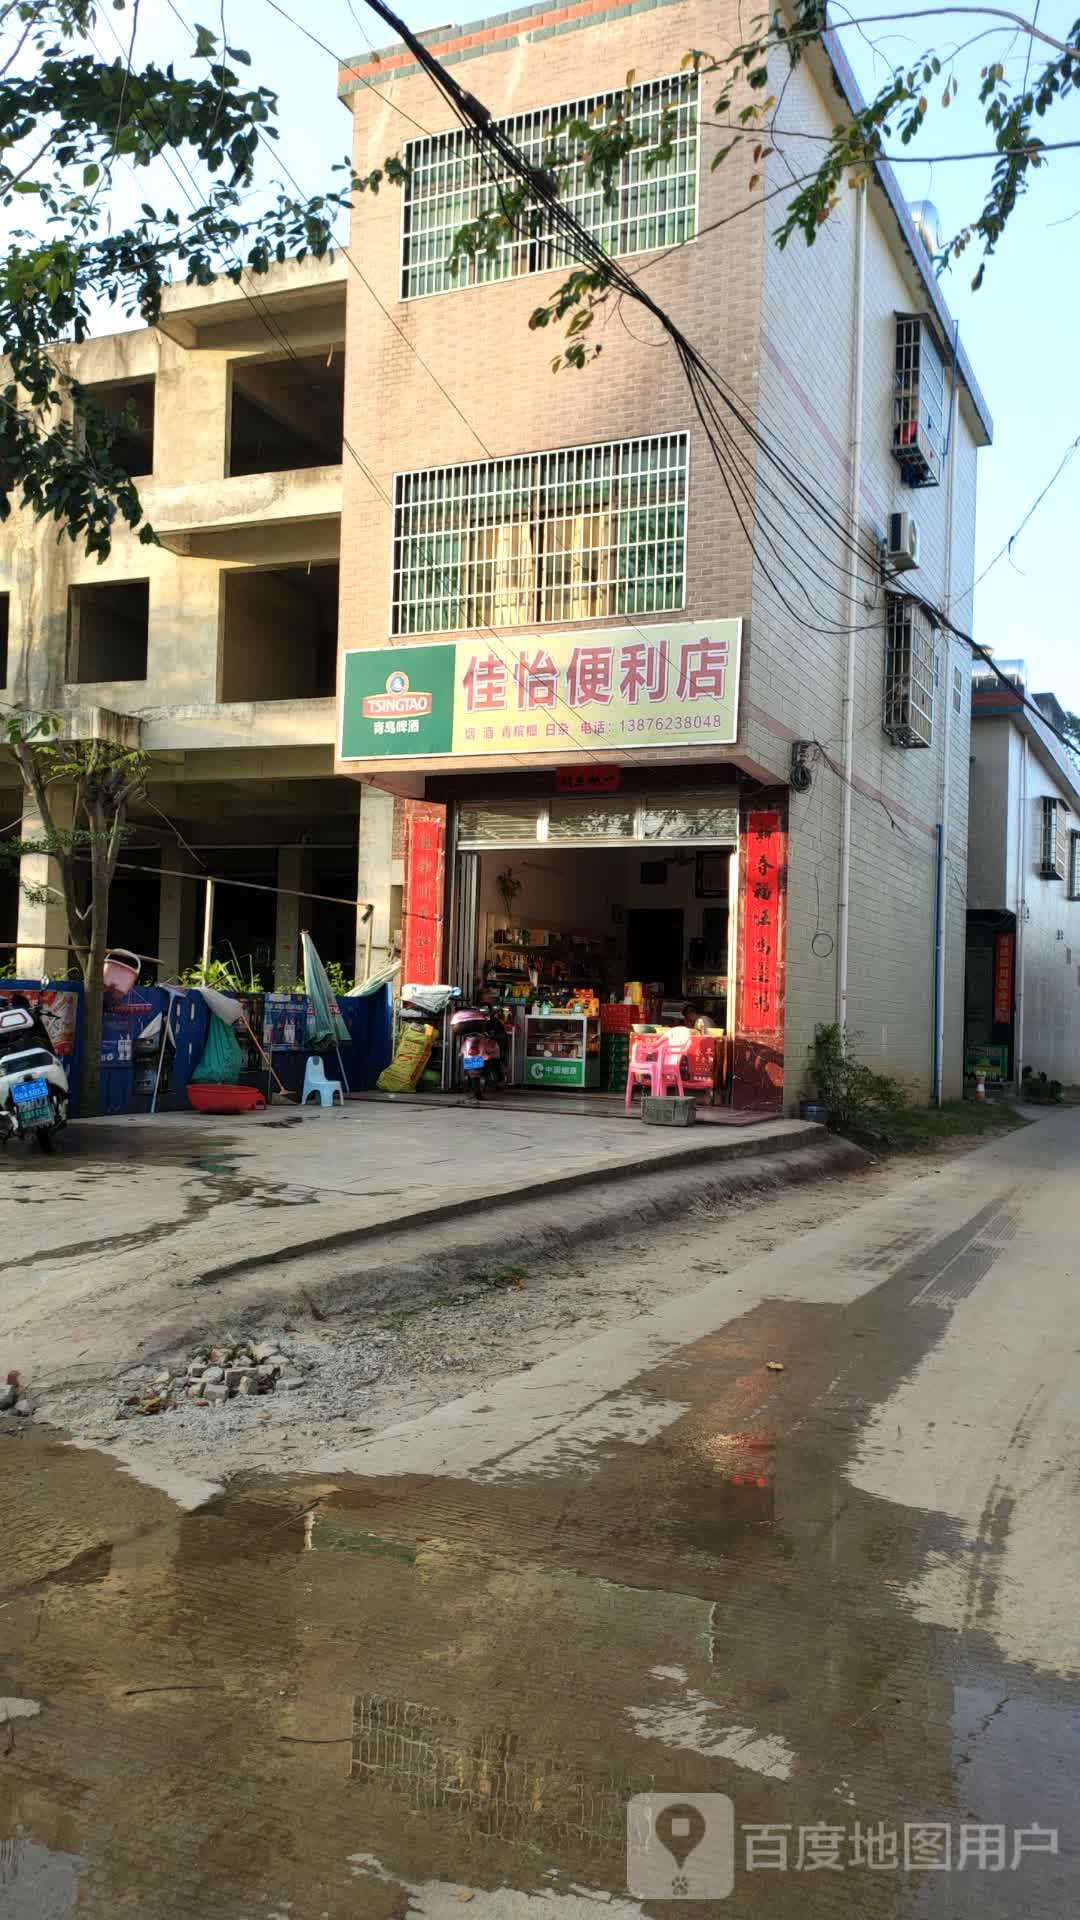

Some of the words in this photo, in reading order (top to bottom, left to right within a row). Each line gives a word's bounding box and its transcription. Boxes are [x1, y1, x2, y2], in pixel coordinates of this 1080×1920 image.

[462, 637, 729, 713] 佳怡便利店
[368, 697, 428, 713] TSINGTAO
[373, 719, 420, 735] 青岛啤酒
[620, 714, 721, 732] 13876238048
